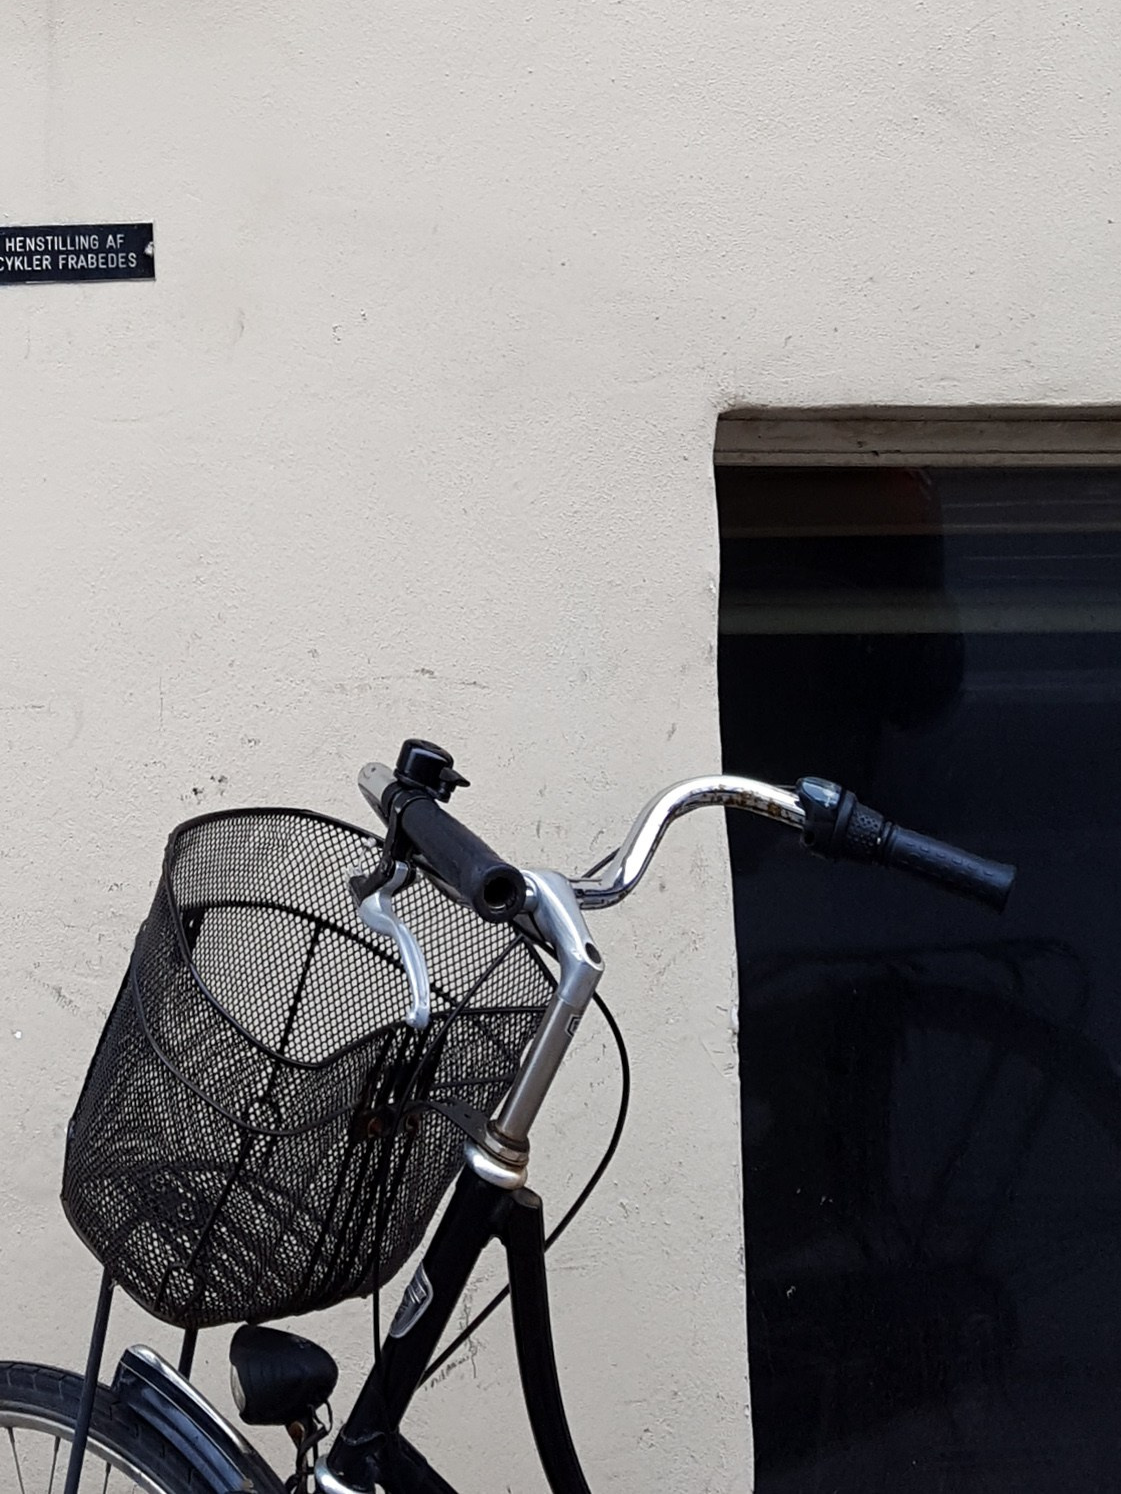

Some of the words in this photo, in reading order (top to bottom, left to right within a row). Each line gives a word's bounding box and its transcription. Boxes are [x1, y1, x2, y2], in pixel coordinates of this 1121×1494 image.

[5, 235, 99, 252] HENSTILLING
[106, 234, 125, 249] AF
[58, 253, 137, 270] FRABEDES
